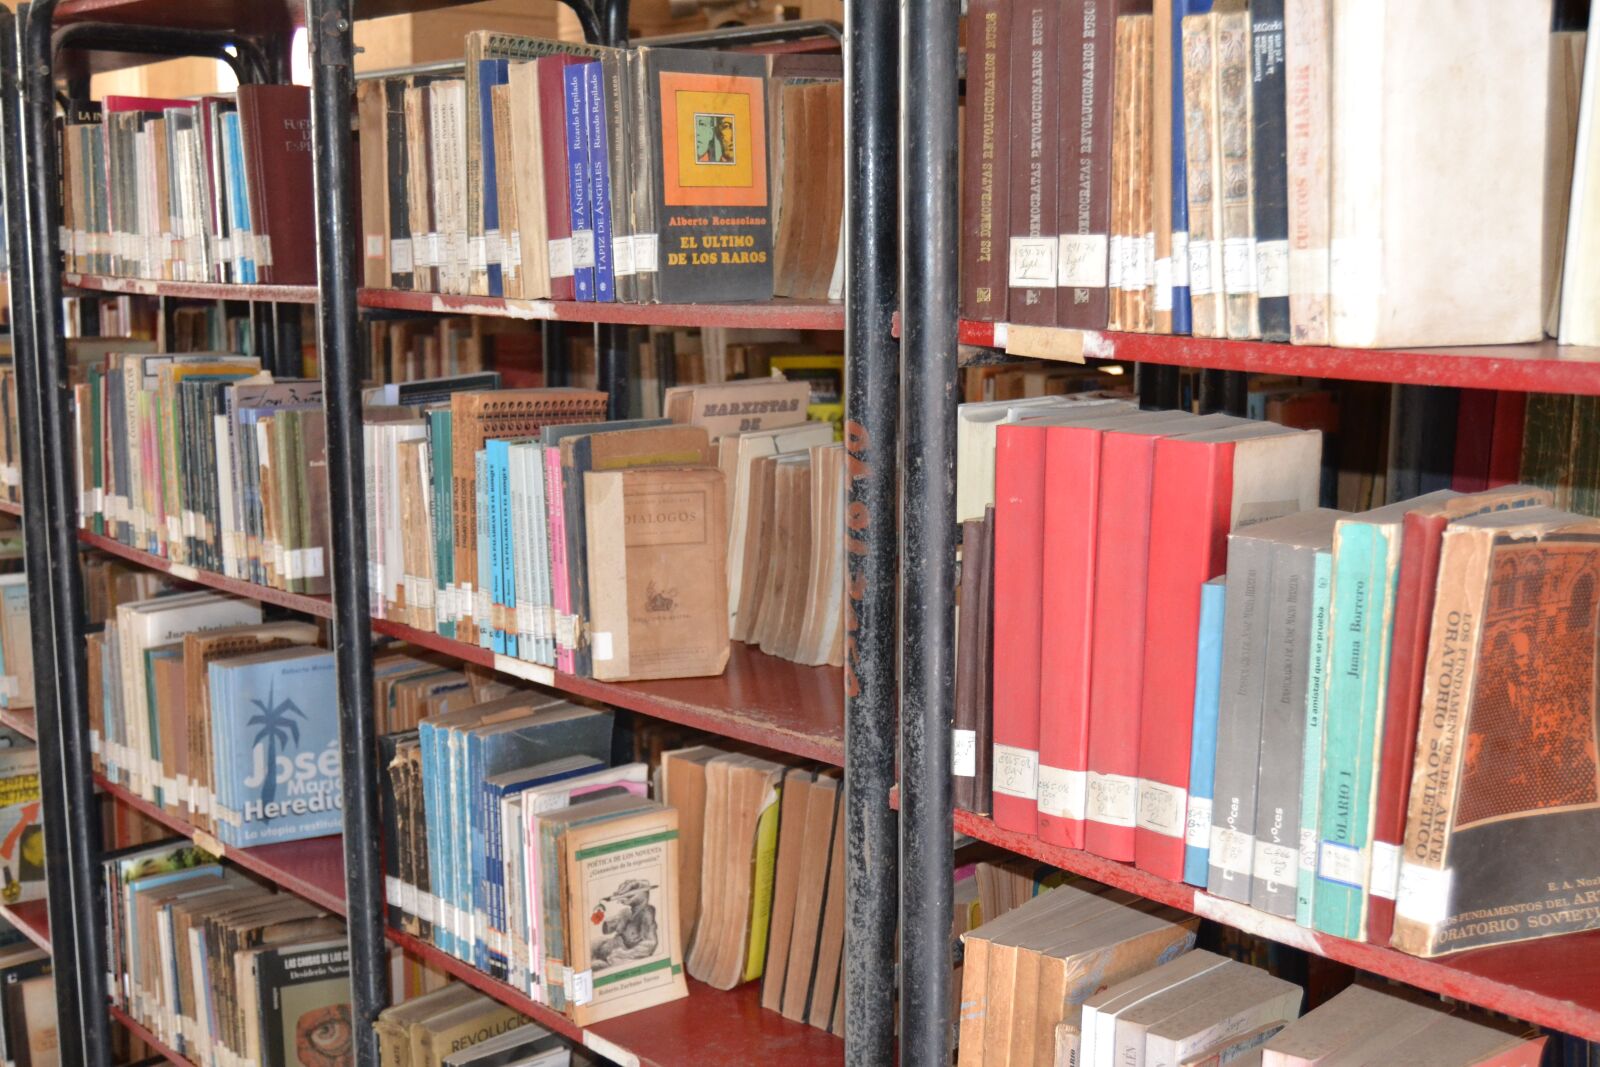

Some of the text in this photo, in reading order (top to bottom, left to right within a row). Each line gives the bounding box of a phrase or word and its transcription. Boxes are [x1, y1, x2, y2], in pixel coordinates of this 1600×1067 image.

[78, 112, 90, 121] LA
[570, 76, 581, 149] Ricardo Repilado
[590, 74, 602, 148] Ricardo Repilado
[982, 53, 996, 159] REVOLUCIONARIOS
[1031, 51, 1043, 158] REVOLUCIONARIOS
[1081, 43, 1095, 153] REVOLUCIONARIOS
[573, 163, 584, 215] ÁNGELES
[980, 163, 993, 238] DEMOCRATAS
[594, 161, 607, 273] TAPIZ DE ÁNGELES
[669, 216, 708, 226] Alberto
[680, 235, 754, 249] EL ULTIMO
[668, 251, 767, 266] DE LOS RAROS
[979, 239, 991, 262] LOS
[703, 399, 800, 417] MARXISTAS
[739, 418, 762, 432] DE
[1347, 580, 1366, 679] Juana Borrero
[1310, 606, 1326, 727] La amistad que se prueba
[1415, 610, 1461, 860] ORATORIO SOVIETICO
[1430, 612, 1472, 863] LOS FUNDAMENTOS DEL ARTE
[243, 740, 341, 789] José
[244, 828, 258, 840] La
[1227, 797, 1240, 832] voces
[1270, 807, 1283, 844] voces
[1335, 783, 1351, 841] OLARIO
[1438, 918, 1520, 944] ORATORIO
[1458, 901, 1543, 922] FUNDAMENTOS
[1545, 898, 1570, 909] DEL
